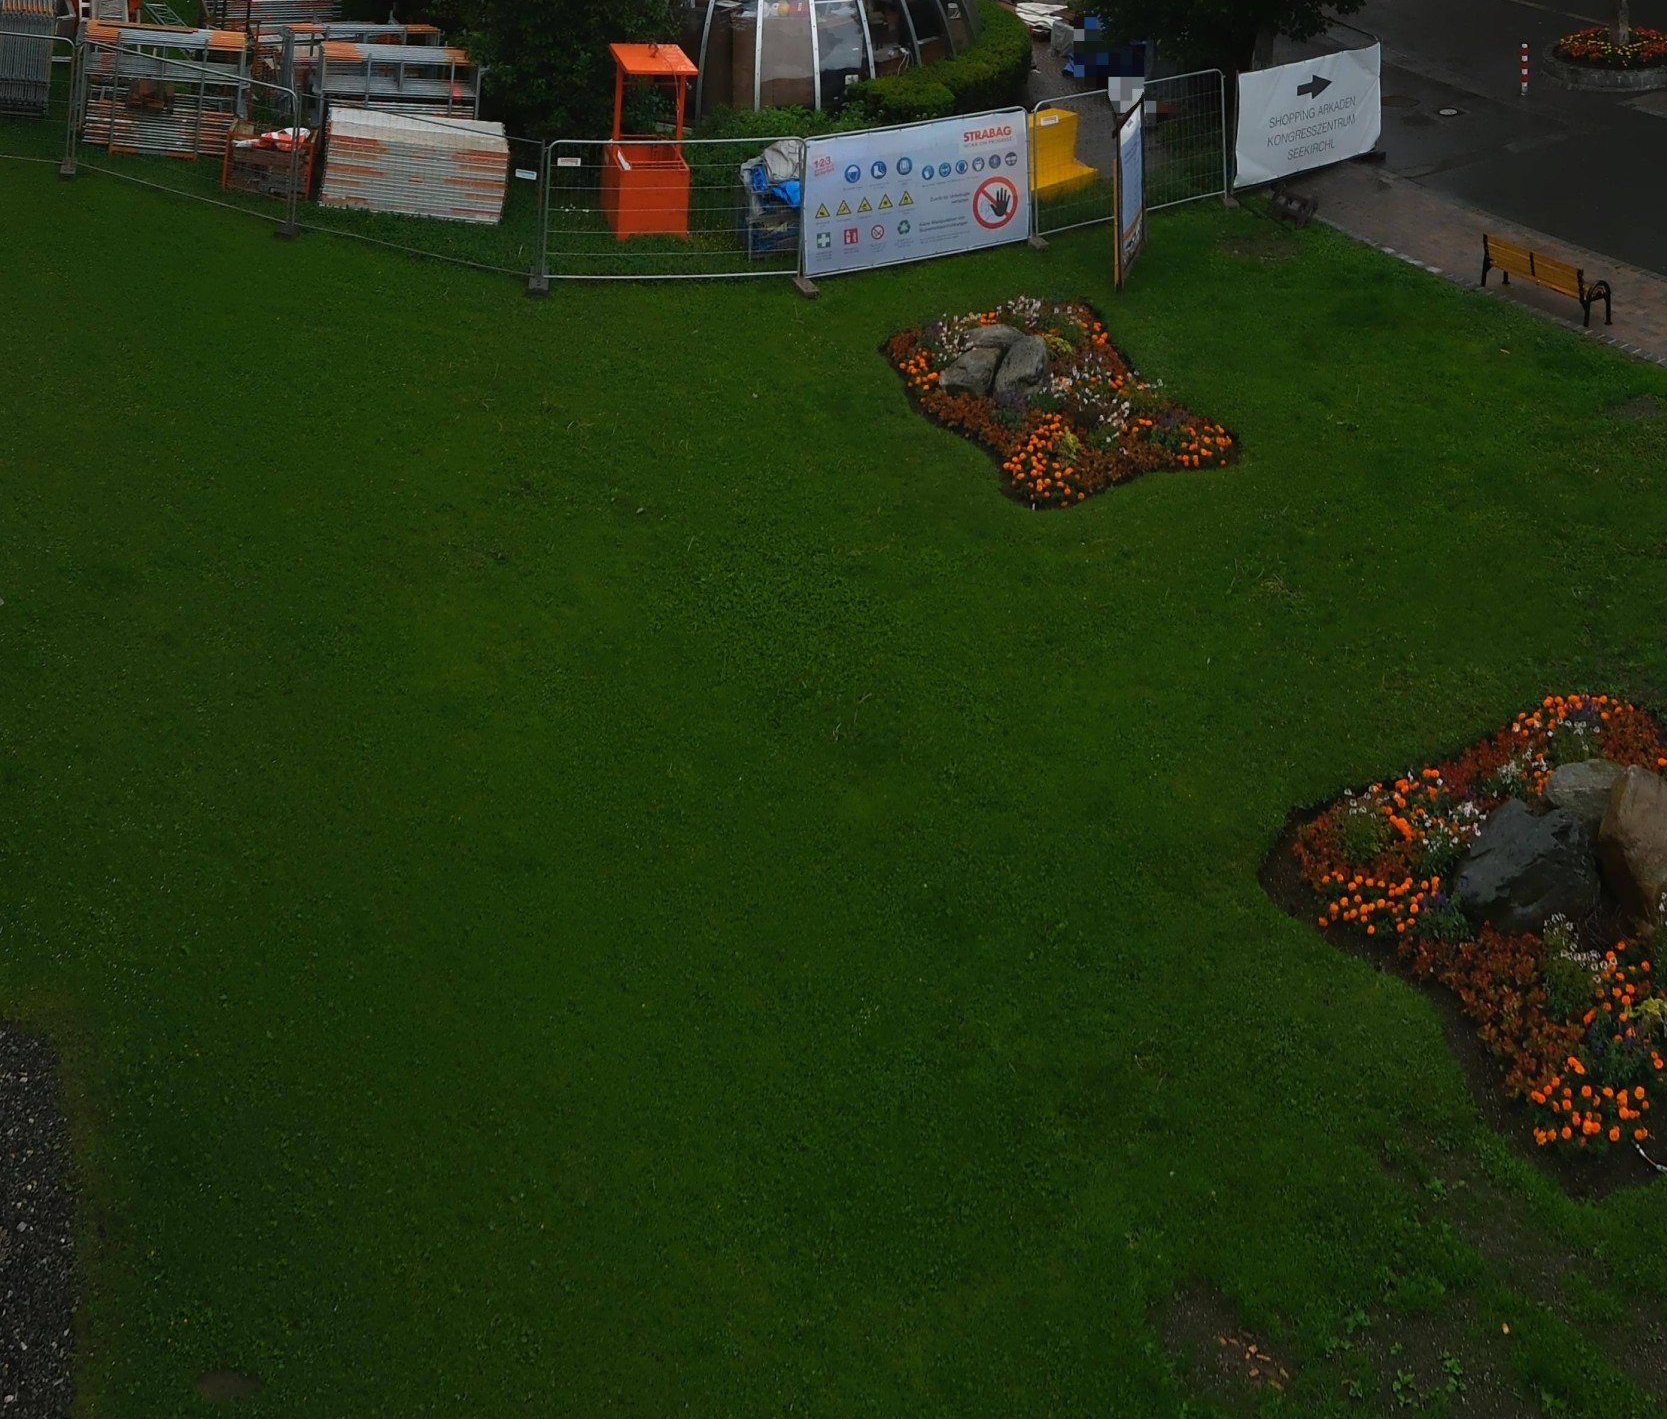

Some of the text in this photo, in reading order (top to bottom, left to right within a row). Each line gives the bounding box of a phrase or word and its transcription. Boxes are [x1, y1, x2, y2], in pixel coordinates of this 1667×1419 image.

[1269, 96, 1356, 129] SHOPPING ARKADEN
[964, 126, 1012, 142] STRABAG
[1267, 114, 1356, 147] KONGRESSZENTRUM
[1287, 139, 1335, 160] SEEKIRCHL
